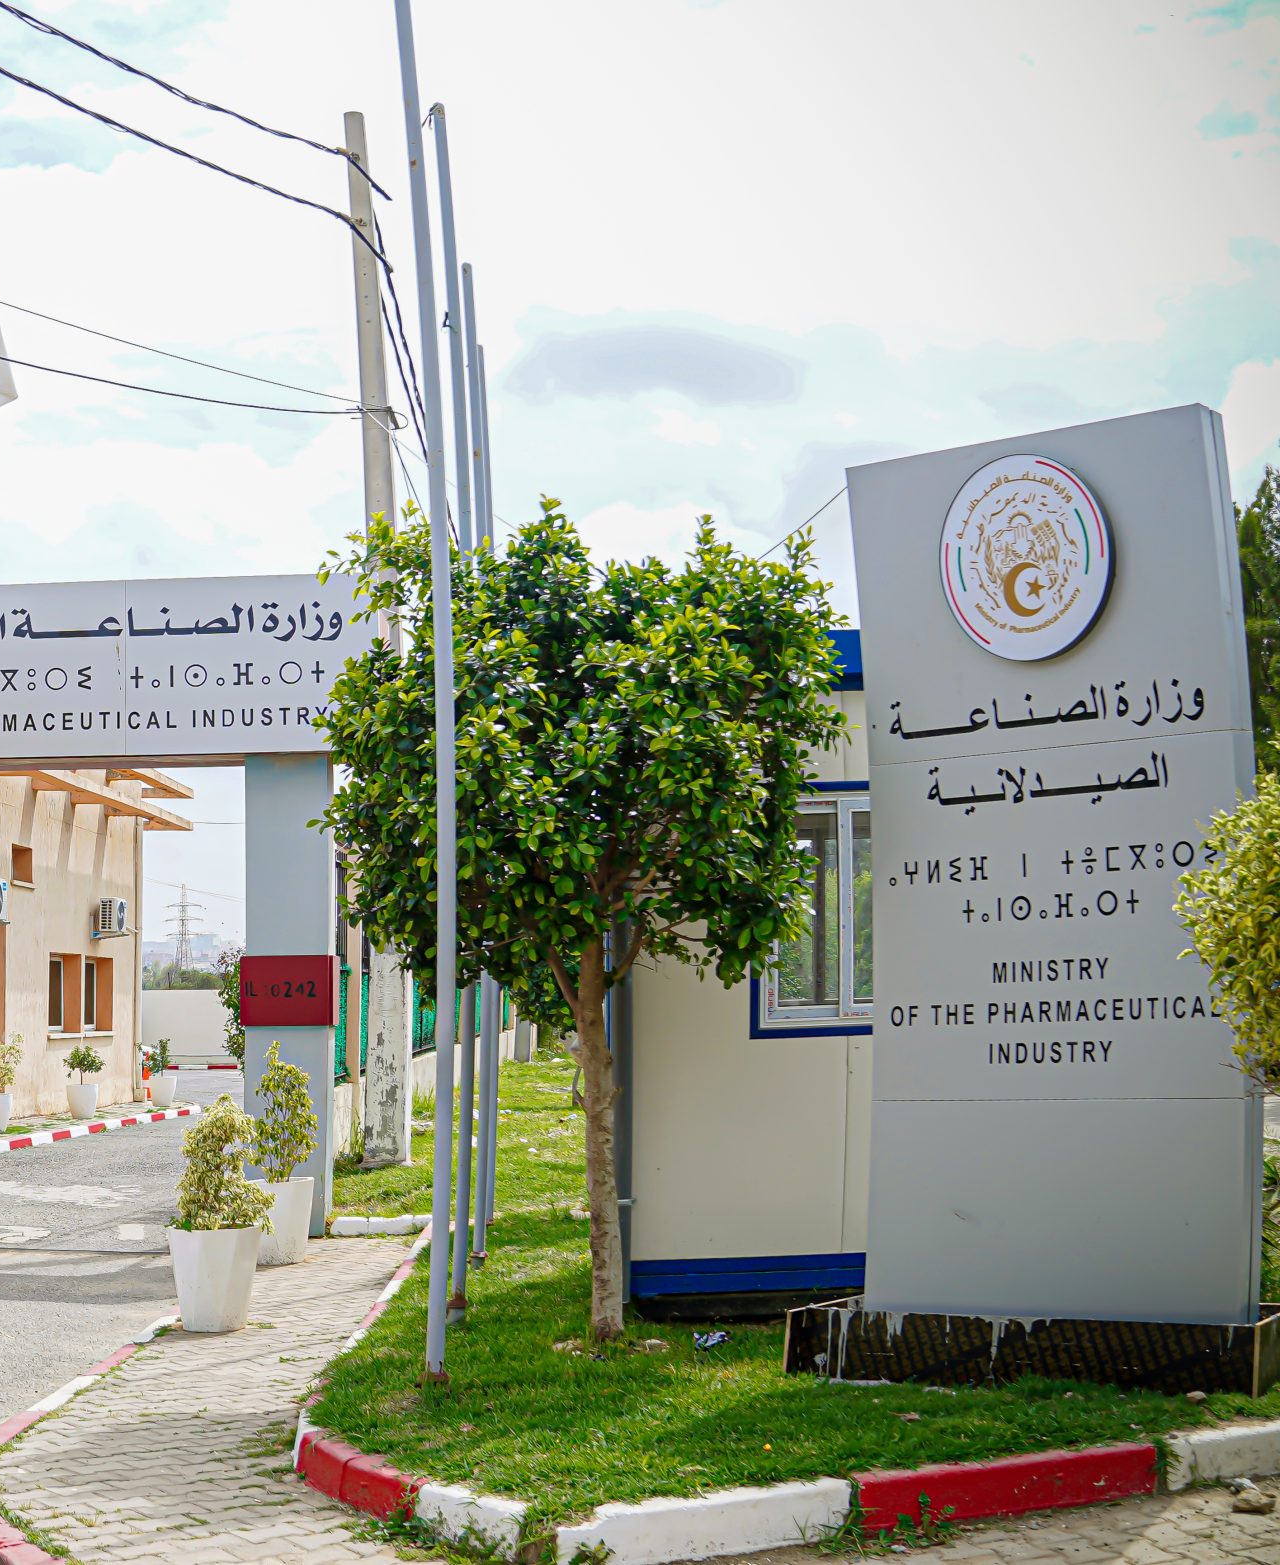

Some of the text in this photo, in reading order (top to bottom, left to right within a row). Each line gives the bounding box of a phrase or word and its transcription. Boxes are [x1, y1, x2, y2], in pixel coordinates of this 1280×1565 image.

[11, 602, 254, 639] الصناعة
[261, 601, 342, 642] وزارة
[192, 706, 328, 729] INDUSTRY
[890, 678, 1206, 740] وزارة الصناعة
[927, 751, 1169, 816] الصيدلانية
[993, 958, 1108, 983] MINISTRY
[891, 1006, 918, 1027] OF
[931, 1004, 974, 1025] THE
[988, 994, 1222, 1024] PHARMACEUTICAL
[990, 1041, 1112, 1064] INDUSTRY
